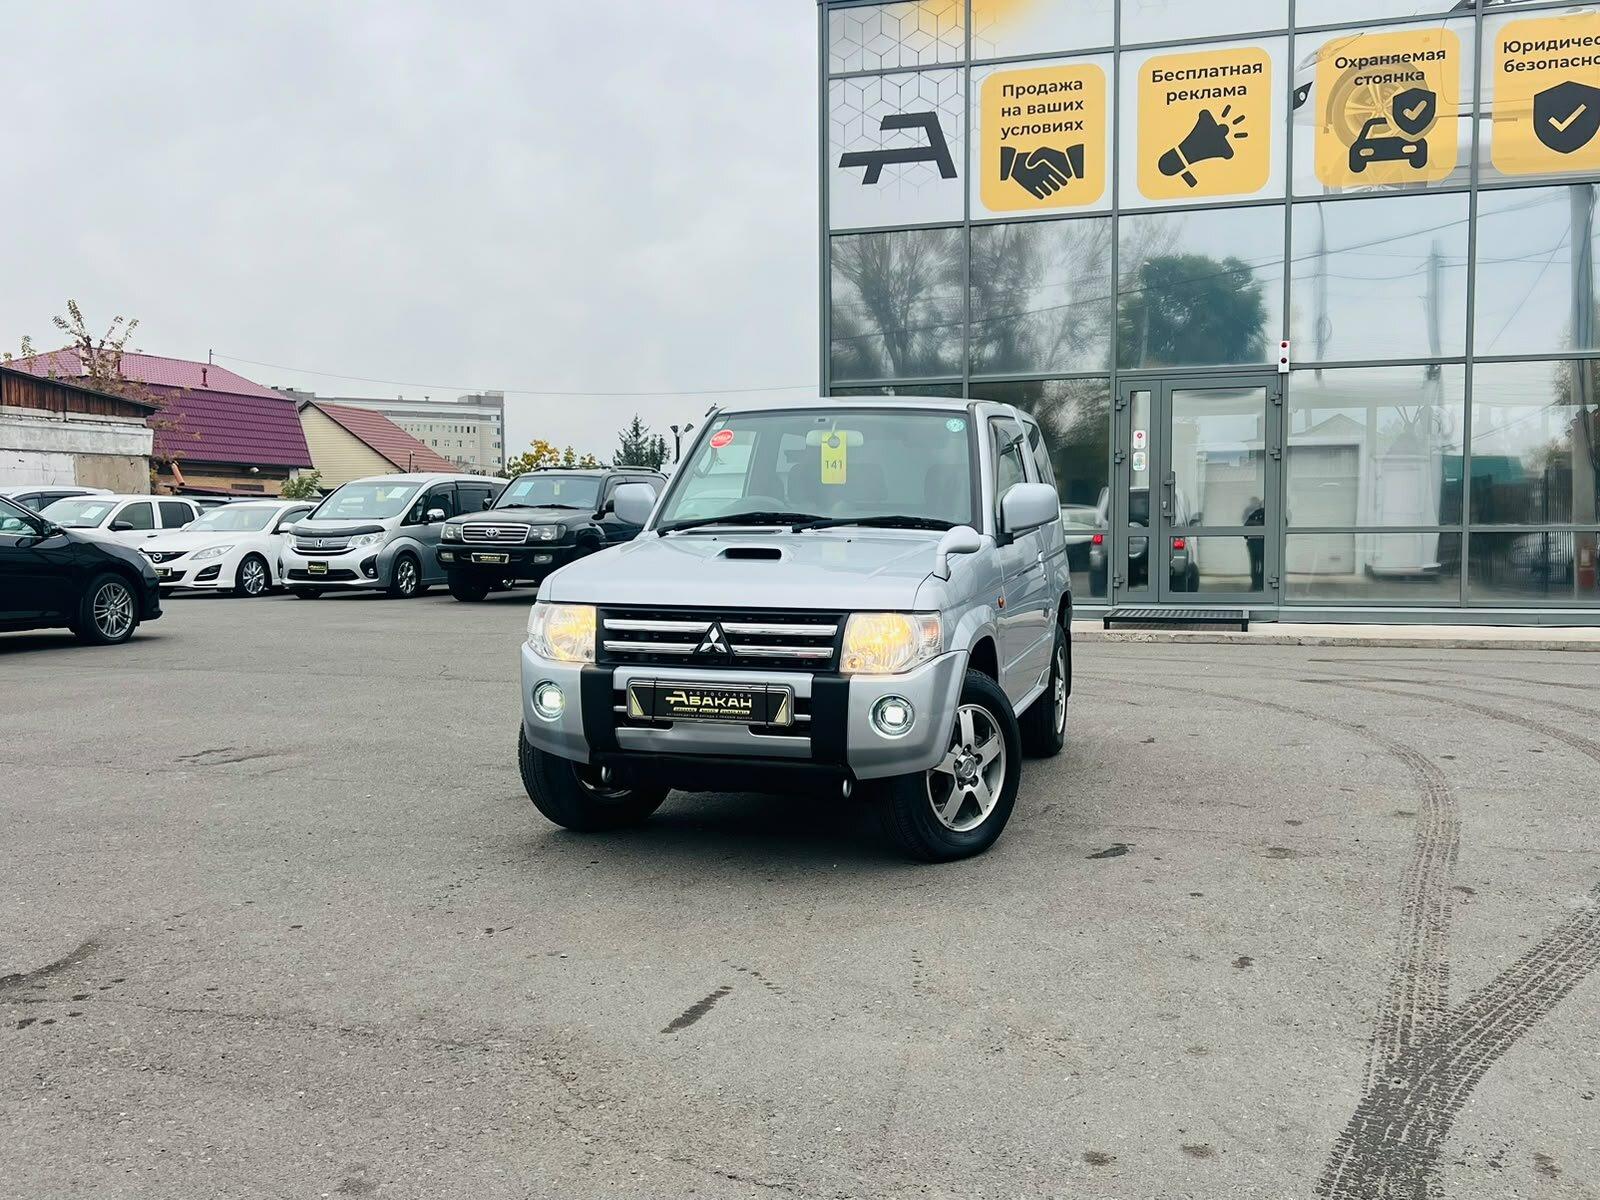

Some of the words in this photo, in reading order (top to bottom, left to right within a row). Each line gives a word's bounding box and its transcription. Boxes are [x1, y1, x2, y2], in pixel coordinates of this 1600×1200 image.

[1503, 36, 1600, 55] Юридичес
[1335, 50, 1446, 70] Охраняемая
[1504, 55, 1600, 73] безопасно
[1152, 63, 1262, 83] Бесплатная
[1354, 71, 1425, 86] стоянка
[1003, 80, 1083, 99] Продажа
[1166, 85, 1247, 105] реклама
[1001, 106, 1021, 117] на
[1027, 100, 1084, 115] ваших
[1001, 120, 1083, 140] условиях
[825, 460, 843, 470] 141
